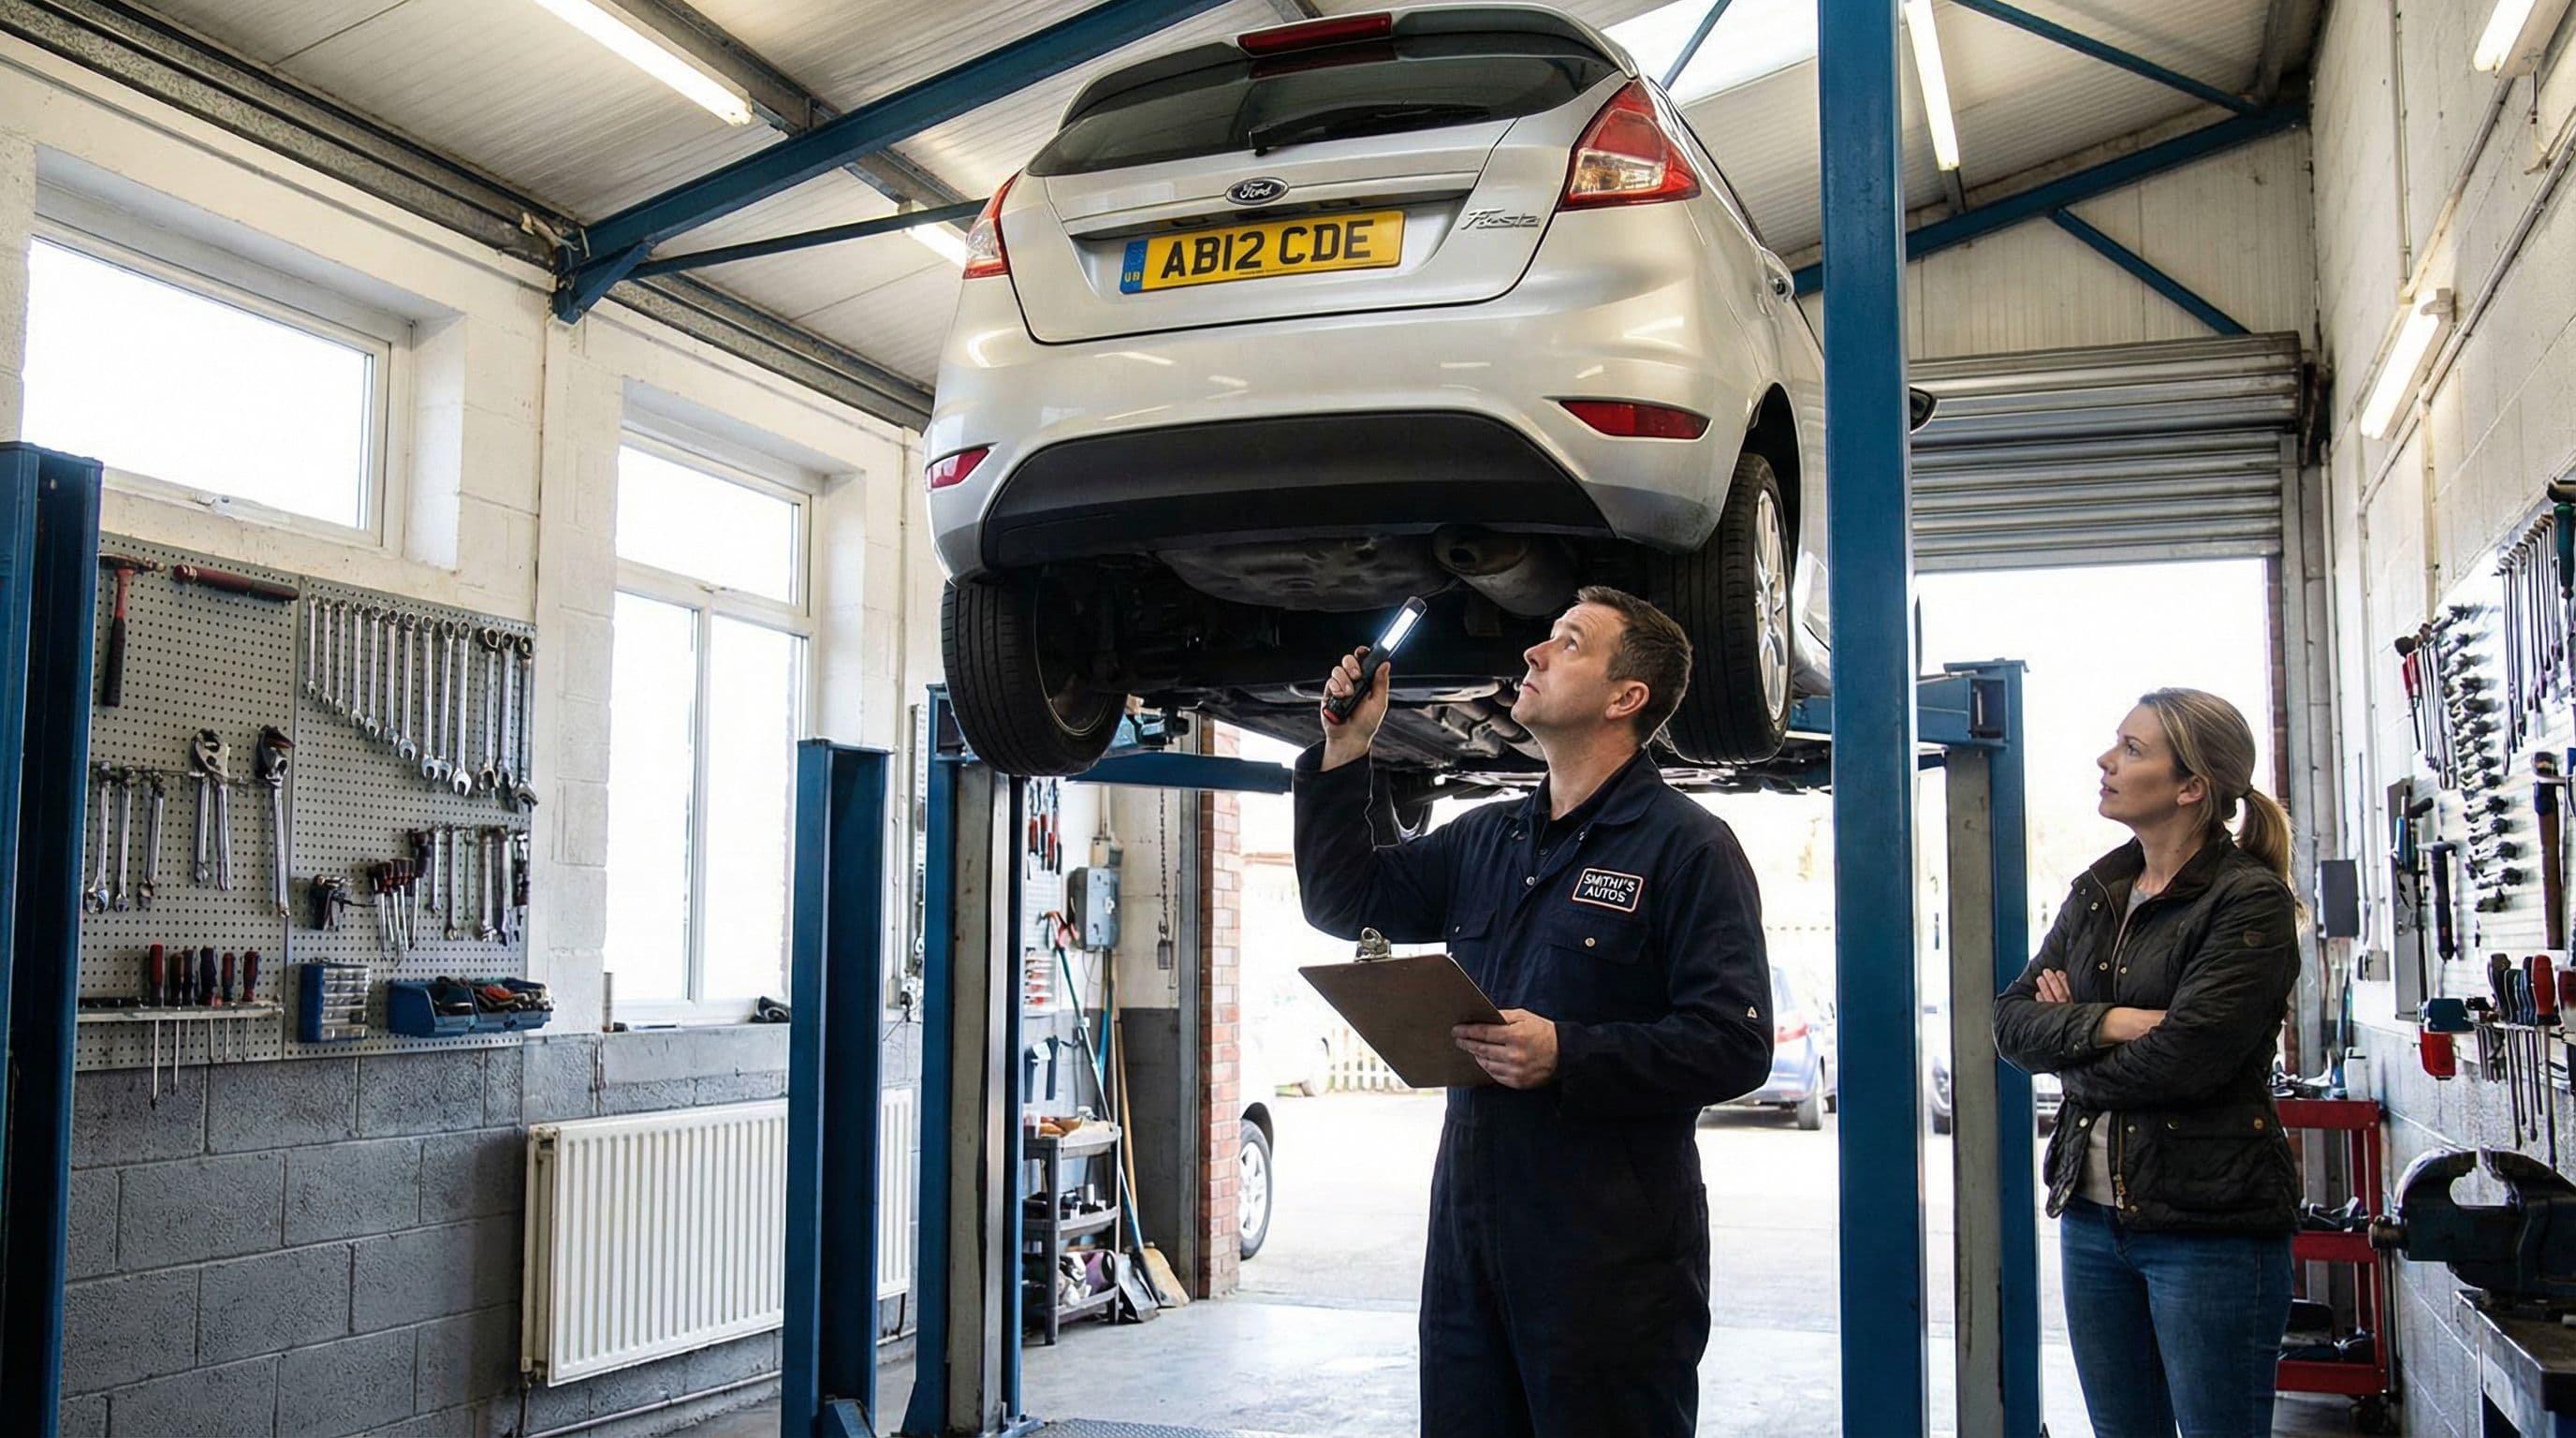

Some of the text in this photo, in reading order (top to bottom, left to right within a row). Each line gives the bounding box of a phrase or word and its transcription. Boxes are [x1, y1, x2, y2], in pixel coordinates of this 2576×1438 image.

[1239, 183, 1274, 199] Ford
[1161, 219, 1375, 279] AB12 CDE
[1585, 886, 1627, 902] AUTOS
